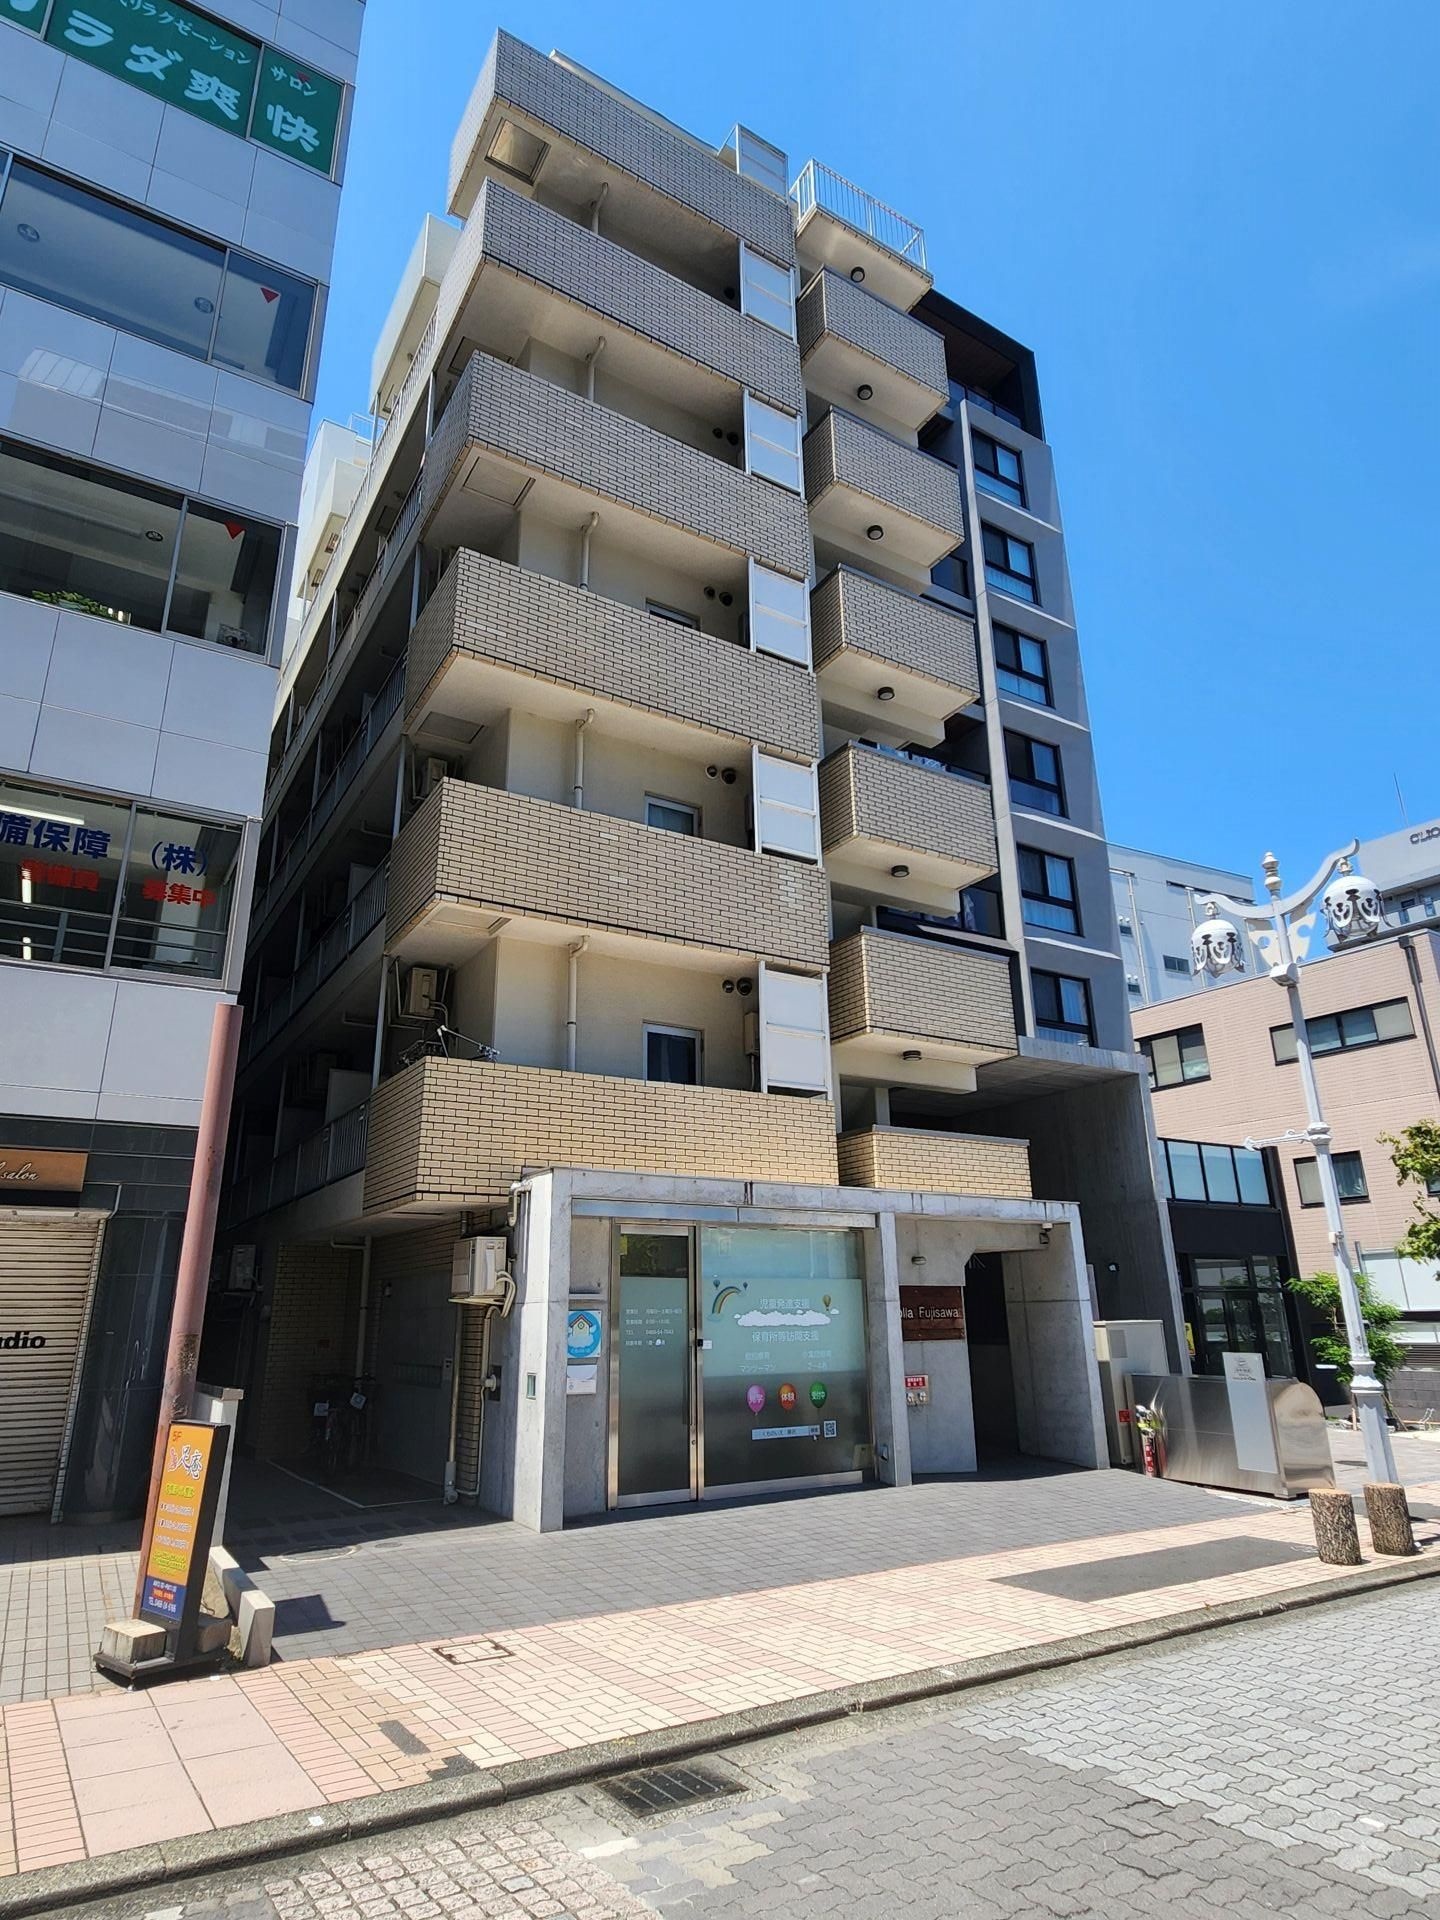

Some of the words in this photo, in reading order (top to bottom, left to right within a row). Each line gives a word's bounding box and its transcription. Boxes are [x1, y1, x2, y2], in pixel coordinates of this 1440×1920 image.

[270, 64, 318, 97] サロン
[918, 1306, 959, 1321] Fujisawa
